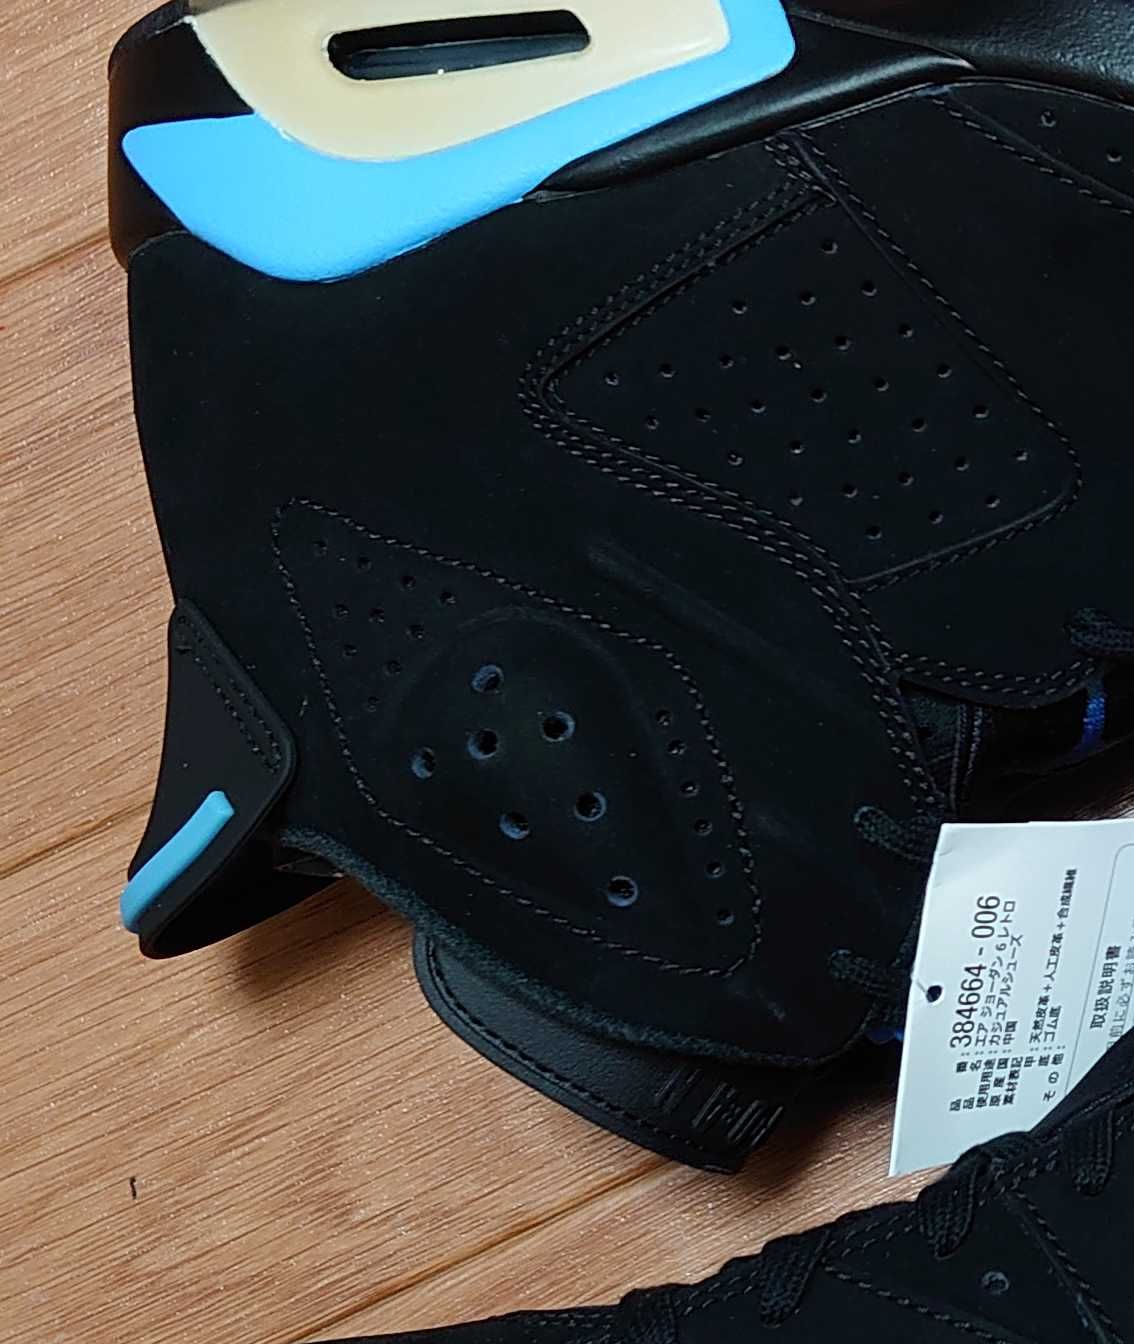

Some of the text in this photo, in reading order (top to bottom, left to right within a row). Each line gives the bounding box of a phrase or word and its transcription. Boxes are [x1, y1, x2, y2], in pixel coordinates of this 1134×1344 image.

[950, 963, 987, 1048] 384664
[971, 895, 1000, 939] 006
[1090, 944, 1121, 1029] 取扱説明書
